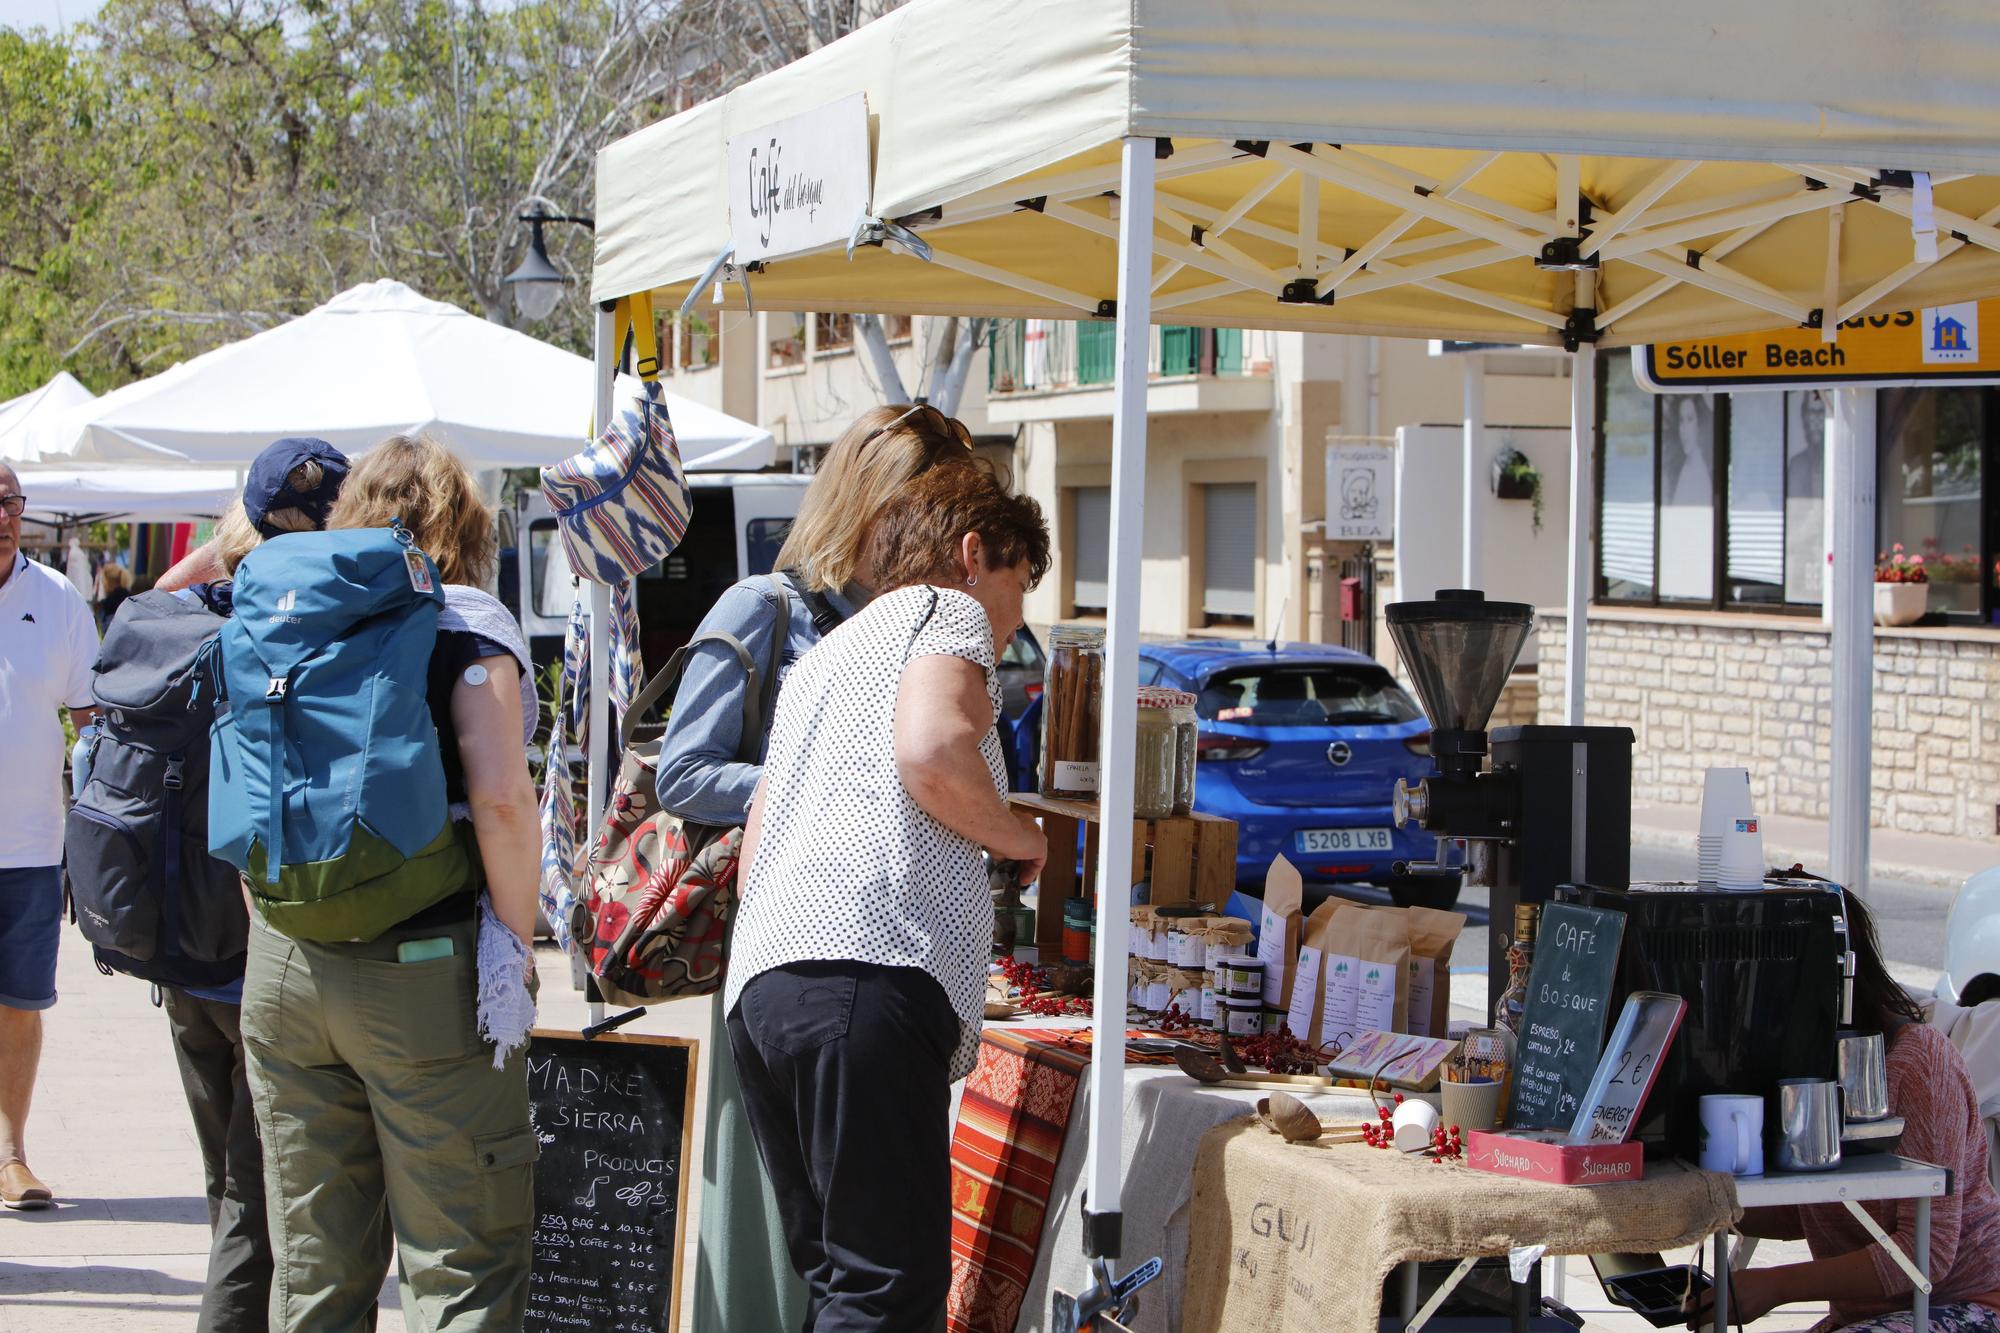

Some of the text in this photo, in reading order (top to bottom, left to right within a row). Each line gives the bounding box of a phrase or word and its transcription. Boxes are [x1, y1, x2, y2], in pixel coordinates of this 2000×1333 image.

[750, 137, 782, 249] Café
[1666, 343, 1846, 369] Sóller Beach
[268, 614, 303, 624] deuter
[1308, 831, 1389, 850] 5208 LXB
[1556, 915, 1601, 957] CAFÉ
[1561, 963, 1572, 983] de
[1540, 983, 1598, 1012] BOSQUE
[526, 1056, 645, 1098] MADRE
[1591, 1105, 1635, 1122] ENERGY
[584, 1149, 675, 1176] PRODUCTS
[1493, 1148, 1531, 1174] SUCHARD
[1580, 1158, 1632, 1178] SUCHARD
[572, 1217, 594, 1229] BAG
